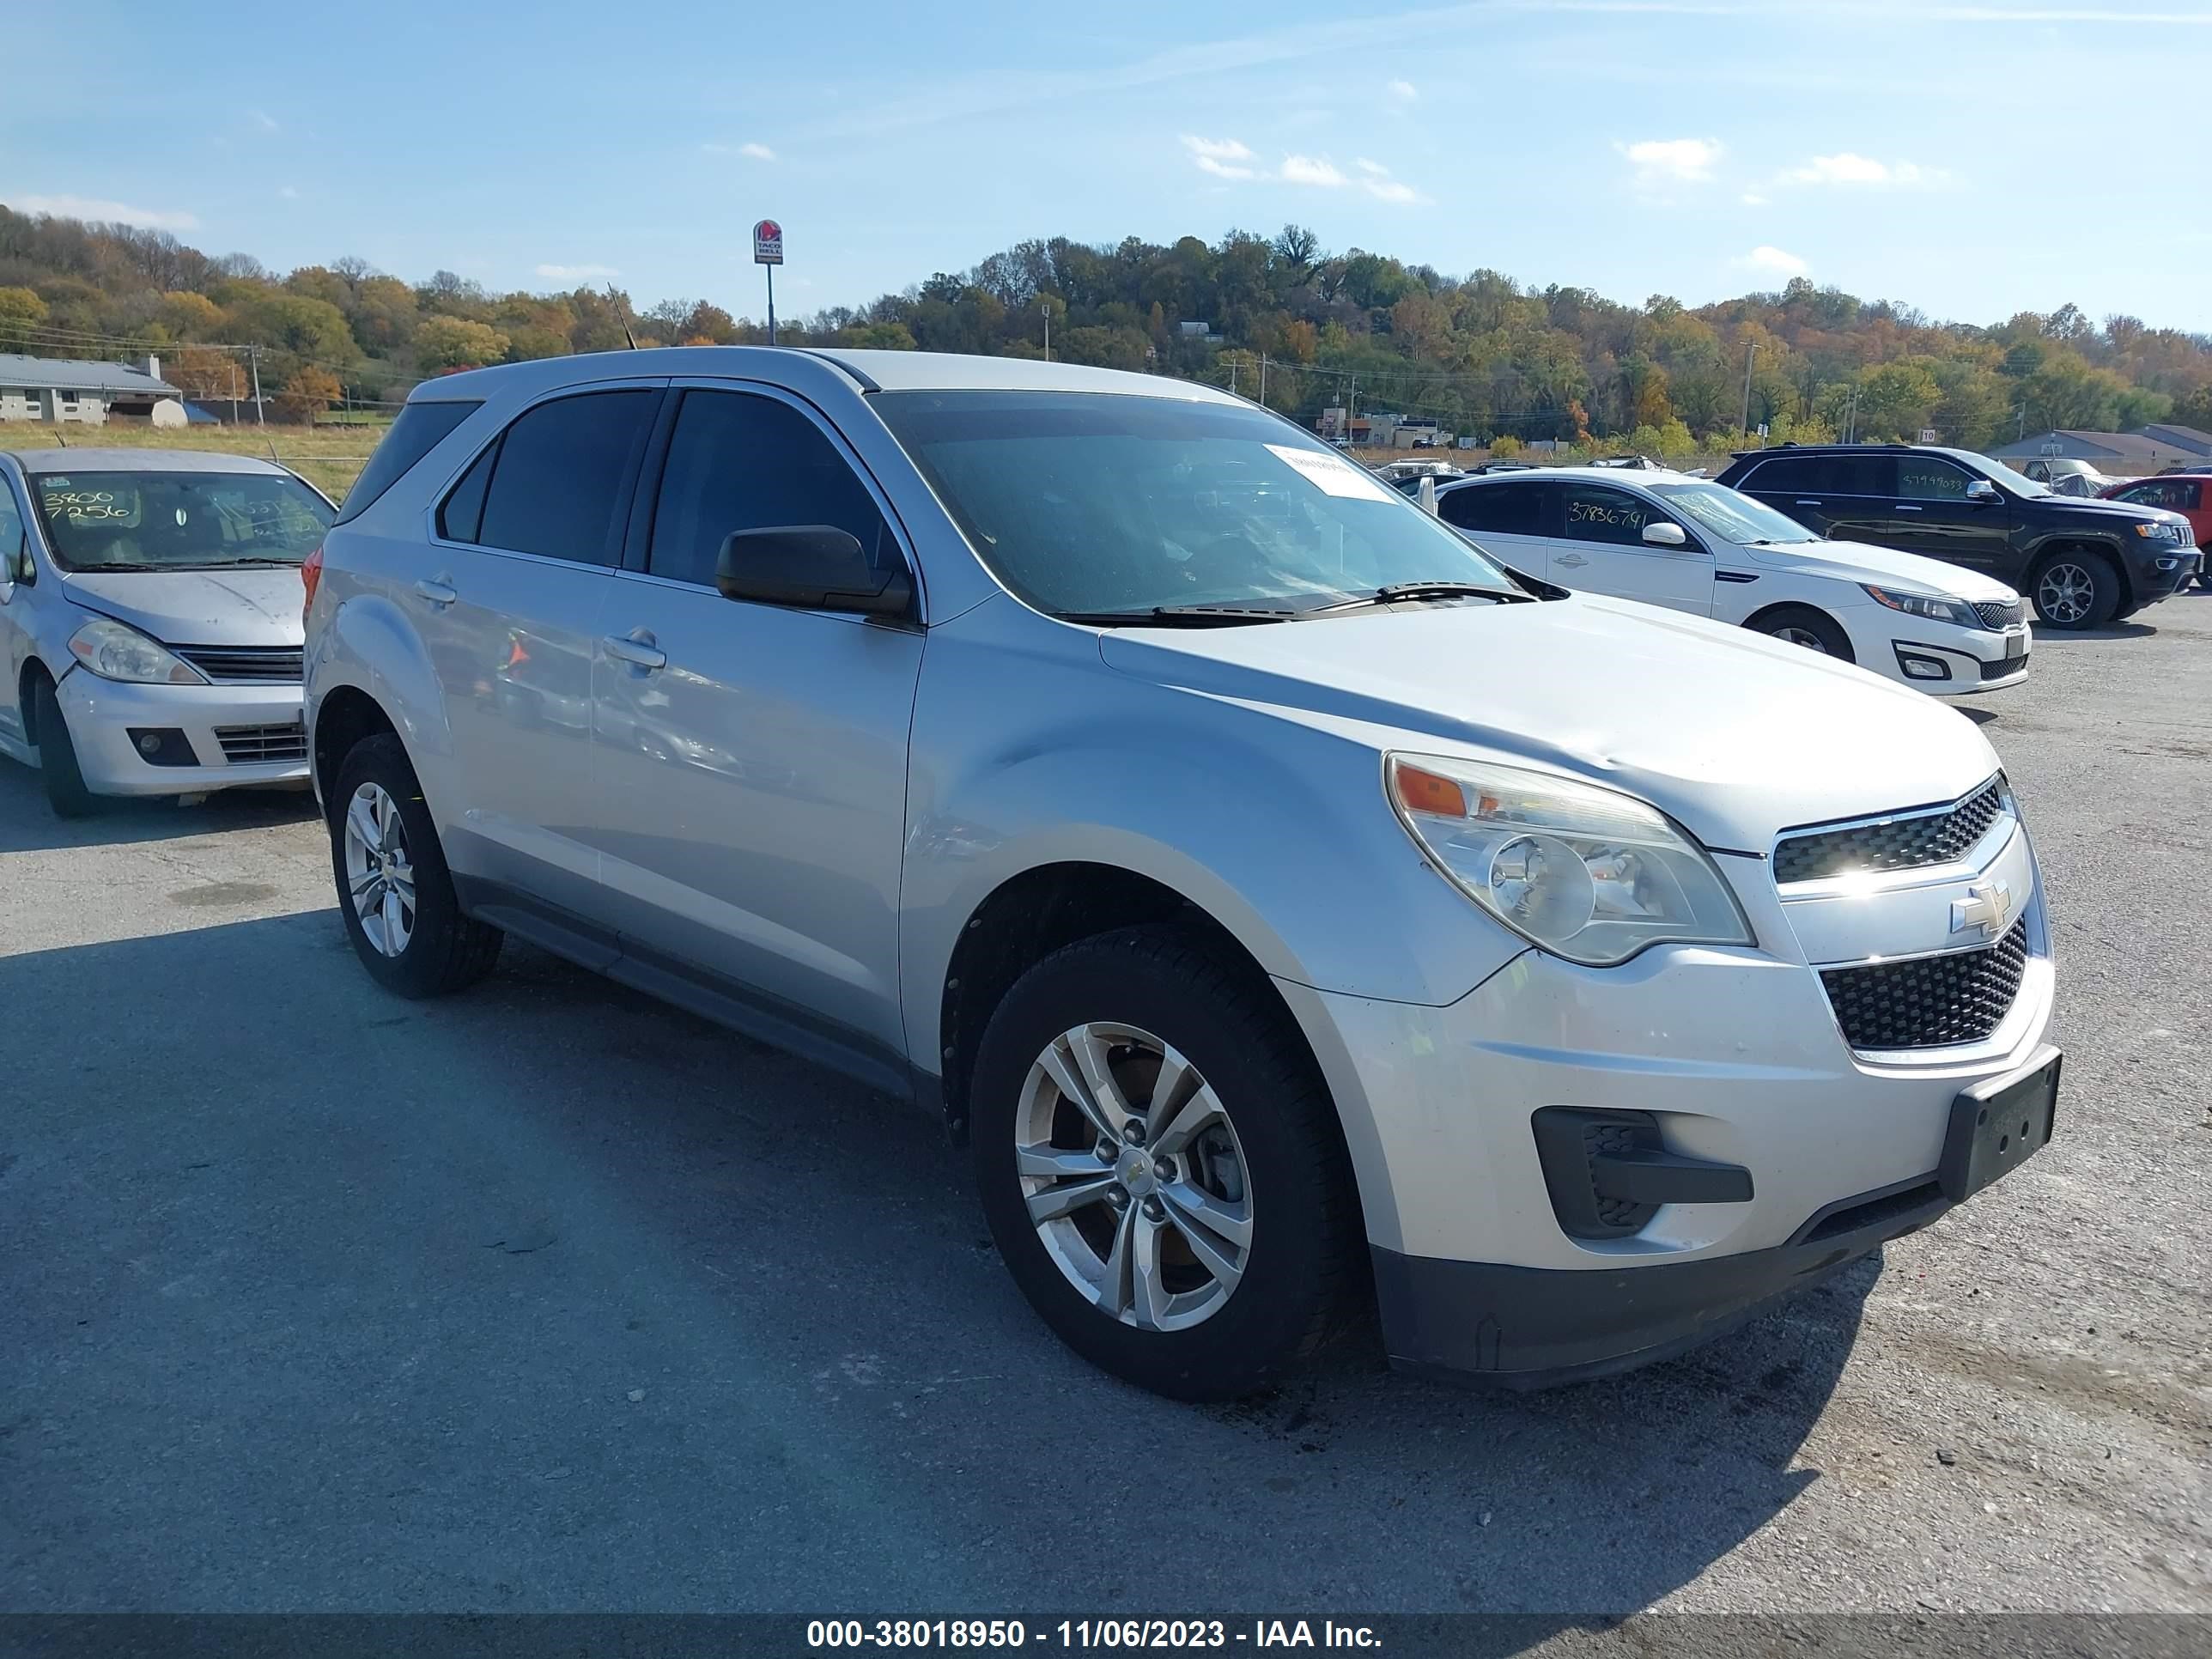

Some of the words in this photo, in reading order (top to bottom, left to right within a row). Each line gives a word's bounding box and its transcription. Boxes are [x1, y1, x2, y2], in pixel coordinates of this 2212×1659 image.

[45, 491, 113, 506] 3800
[45, 505, 131, 519] 7256
[1570, 502, 1648, 529] 37836791
